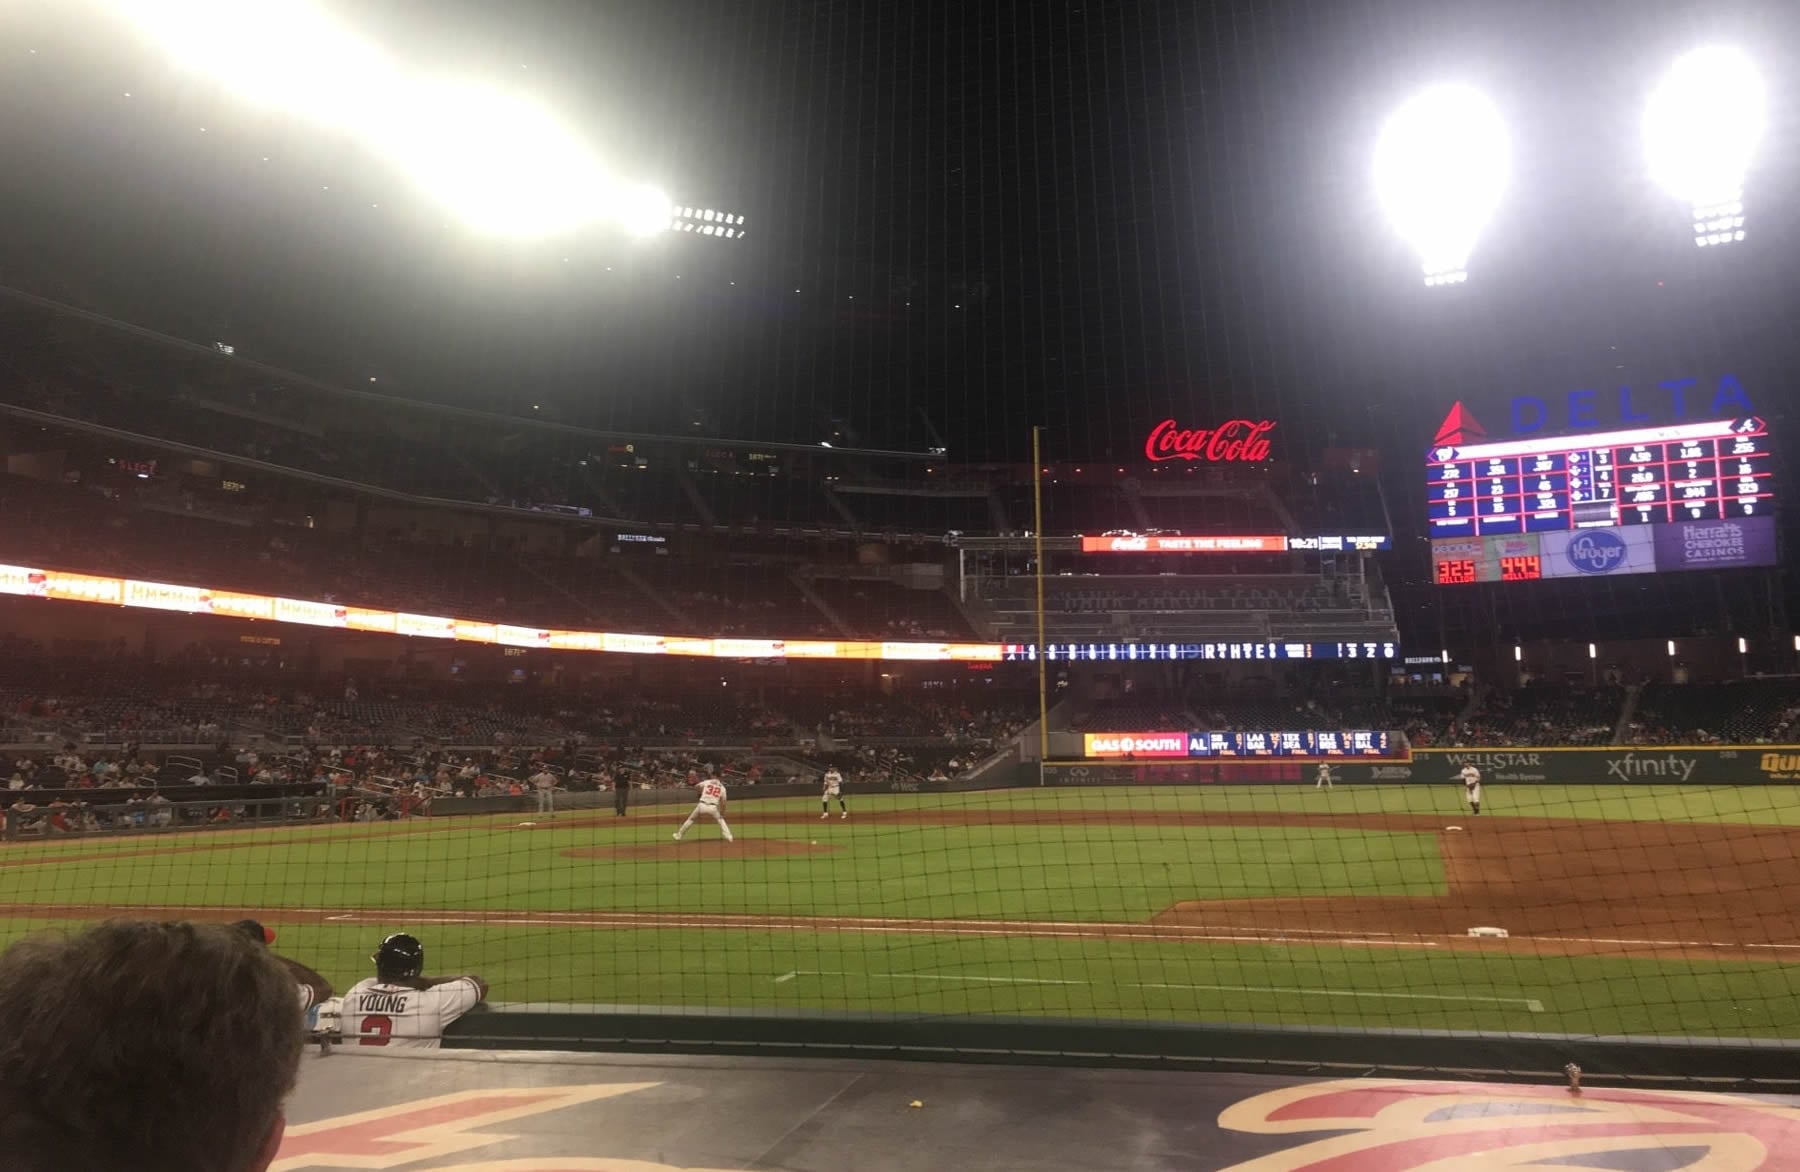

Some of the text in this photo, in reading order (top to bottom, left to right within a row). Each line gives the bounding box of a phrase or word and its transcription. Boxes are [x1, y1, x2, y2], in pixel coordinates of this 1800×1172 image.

[1511, 373, 1754, 433] DELTA
[1146, 419, 1276, 461] Coca-Cola
[1685, 538, 1744, 549] CHEROKEE
[1573, 537, 1622, 568] Kroger
[1685, 547, 1744, 558] CASINOS
[1439, 560, 1474, 576] 325
[1205, 644, 1215, 659] R
[1231, 644, 1240, 658] H
[1255, 644, 1264, 658] E
[1366, 648, 1375, 658] 2
[1091, 738, 1180, 750] GAS SOUTH
[1190, 738, 1207, 750] AL
[1446, 752, 1541, 769] WELLSTAR
[1607, 753, 1696, 781] xfinity
[705, 784, 721, 798] 32
[359, 994, 407, 1013] YOUNG
